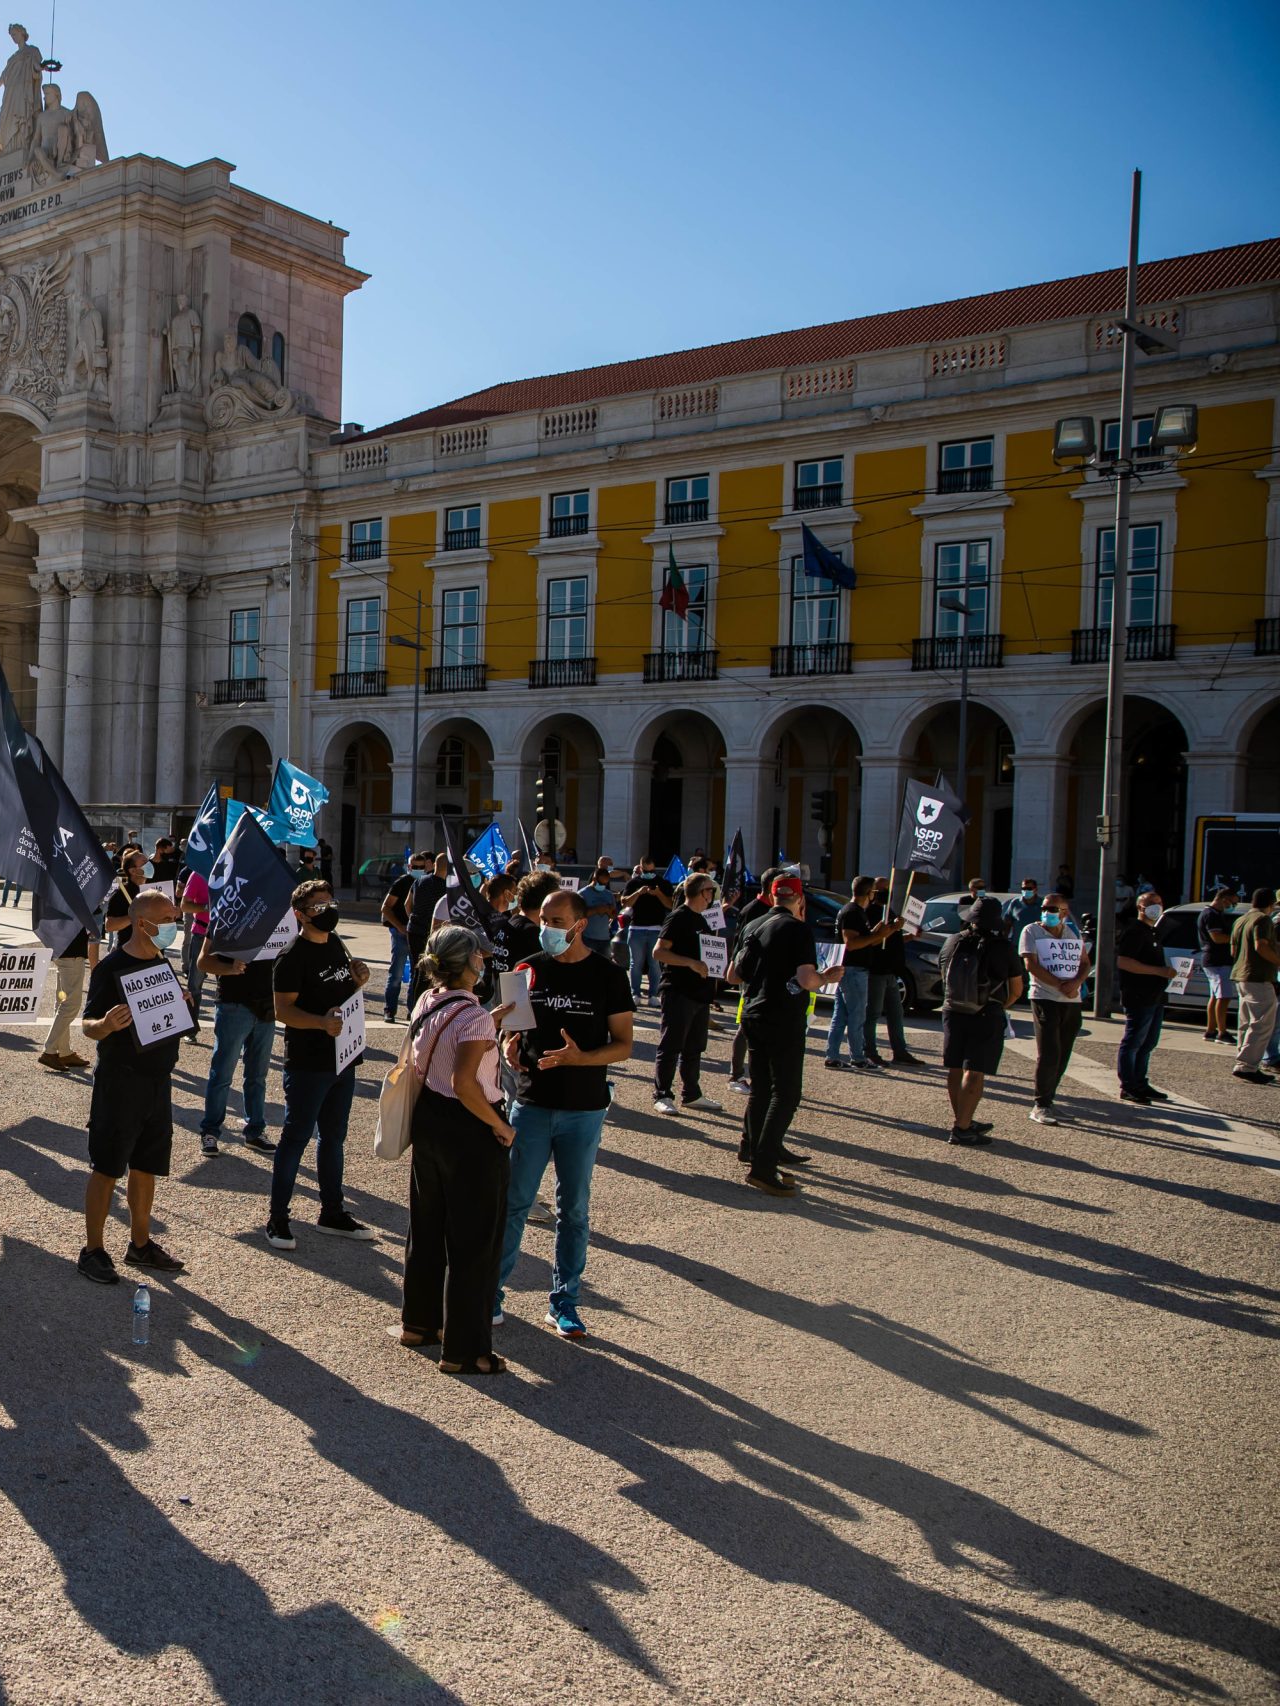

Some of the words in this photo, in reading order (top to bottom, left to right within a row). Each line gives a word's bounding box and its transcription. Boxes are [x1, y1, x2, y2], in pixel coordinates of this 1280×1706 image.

[19, 836, 32, 848] dos
[16, 846, 25, 856] da
[18, 953, 36, 970] HÁ
[8, 978, 33, 989] PARA
[125, 979, 143, 993] NÃO
[144, 971, 173, 987] SOMOS
[137, 991, 174, 1011] POLÍCIAS
[547, 997, 572, 1008] VIDA
[341, 1000, 359, 1020] IDAS
[152, 1022, 161, 1032] de
[348, 1026, 352, 1035] A
[340, 1035, 362, 1063] SALDO
